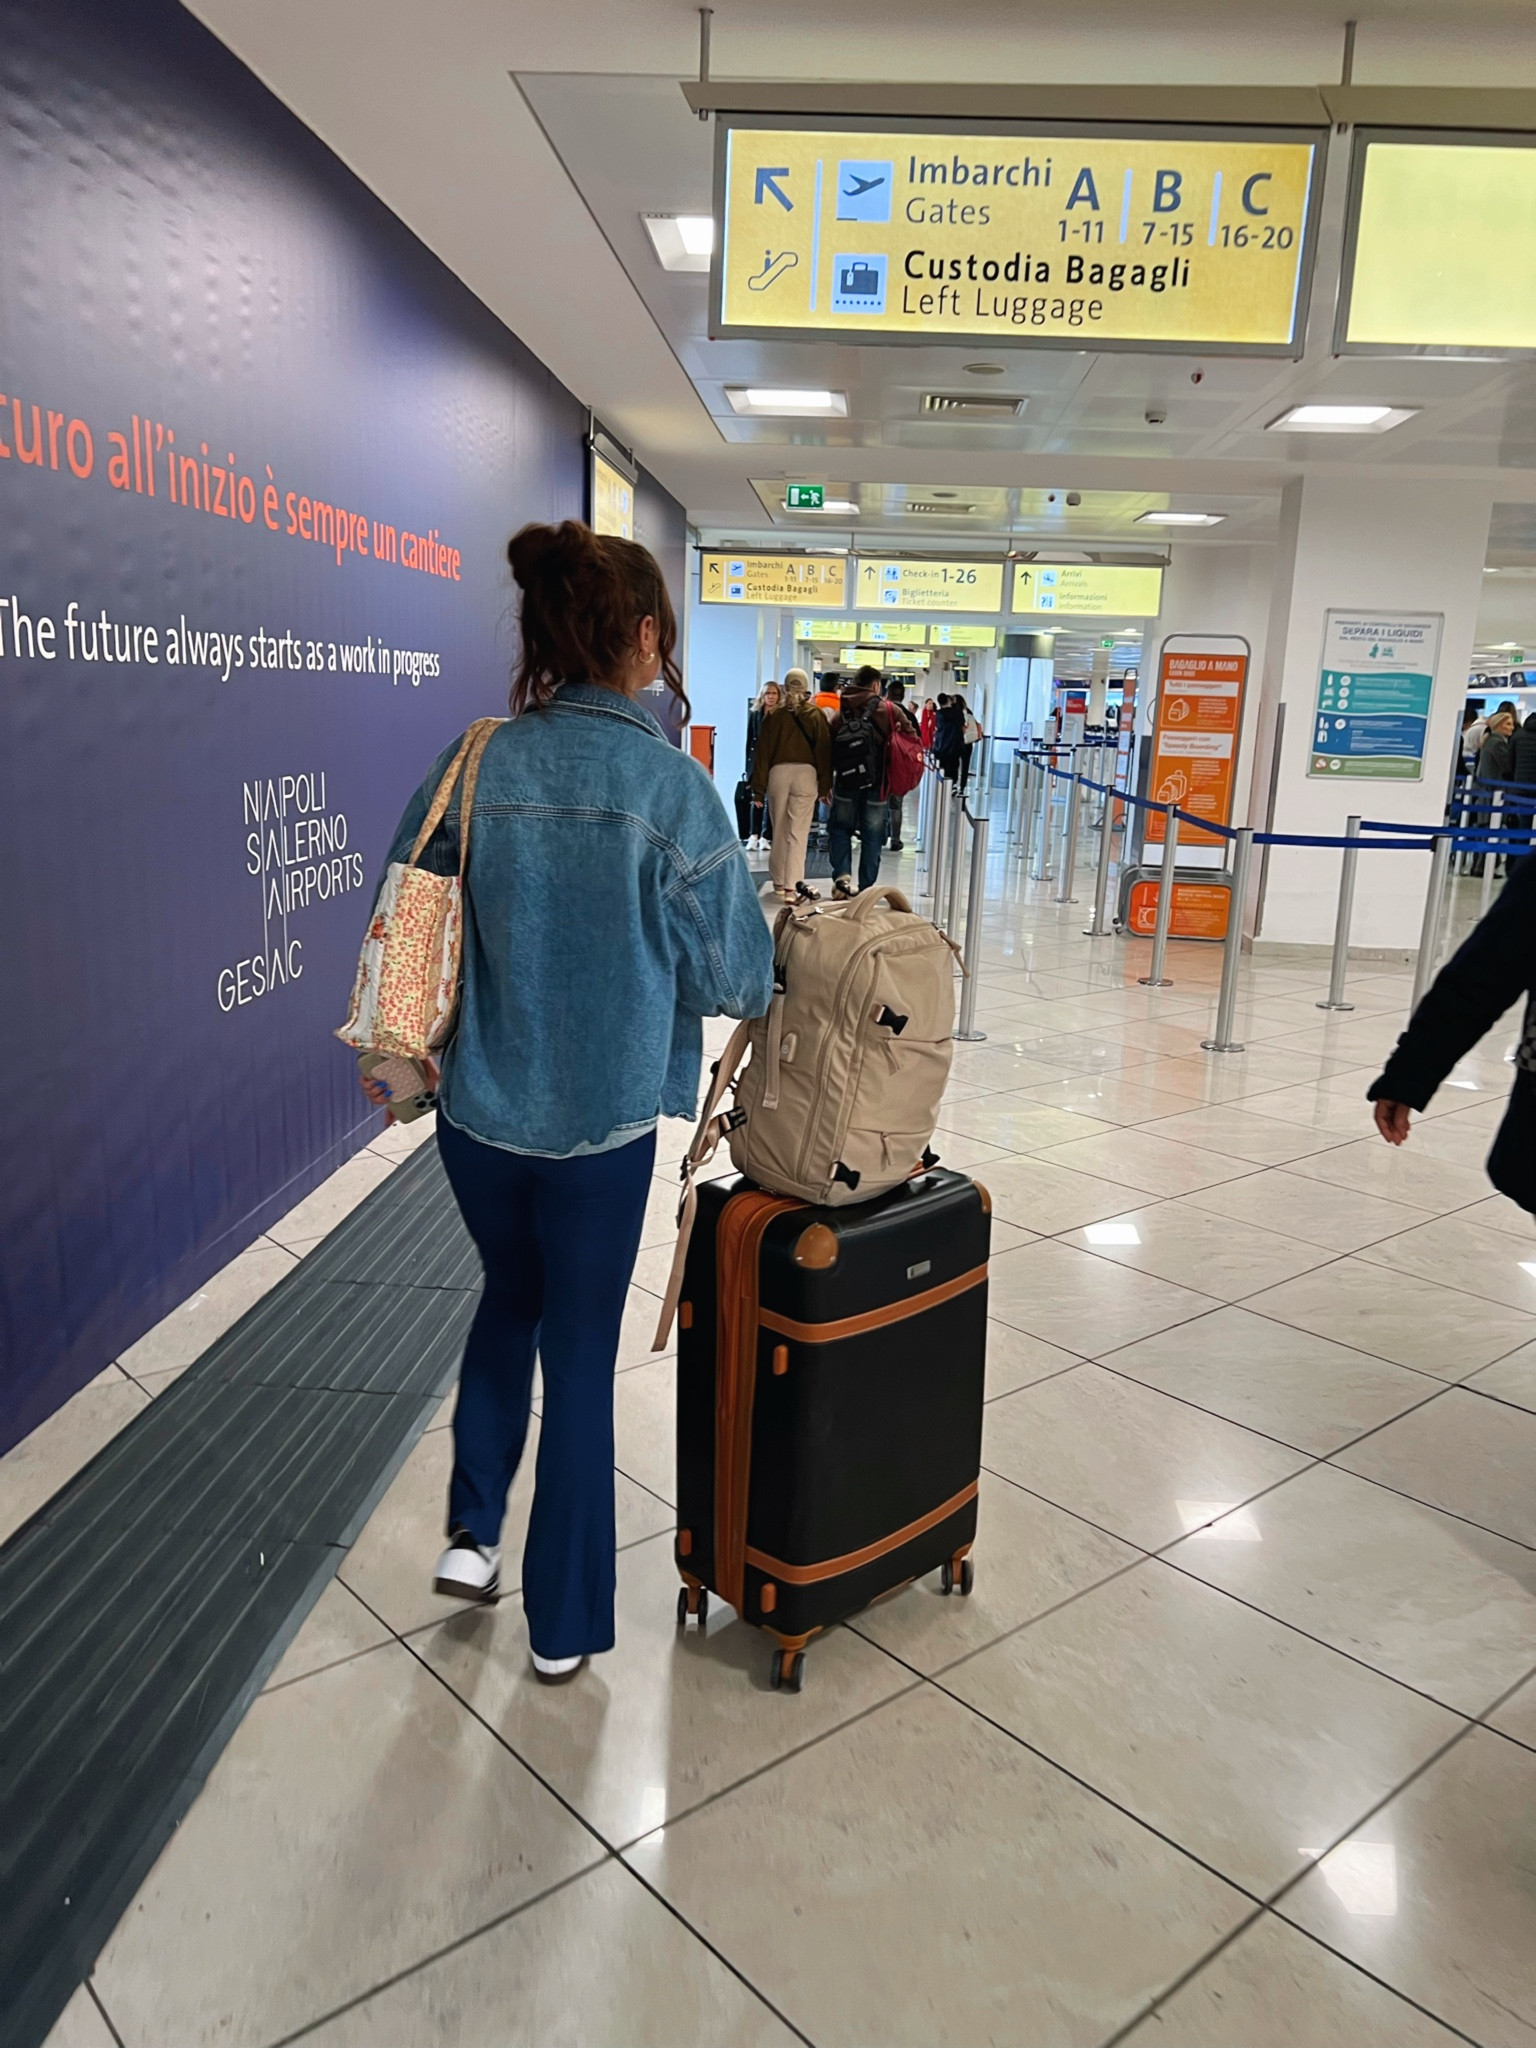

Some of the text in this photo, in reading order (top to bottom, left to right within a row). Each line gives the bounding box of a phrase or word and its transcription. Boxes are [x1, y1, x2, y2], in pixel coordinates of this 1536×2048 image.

[909, 155, 1272, 215] Imbarchi A B C
[906, 197, 990, 225] Gates
[1058, 220, 1293, 249] 1-11 7-15 16-20
[904, 250, 1190, 292] Custodia Bagagli
[903, 285, 1103, 326] Left Luggage
[263, 463, 280, 531] è
[285, 491, 369, 566] sempre
[373, 521, 397, 563] un
[400, 529, 461, 581] cantiere
[746, 561, 837, 577] Imbarchi A B C
[902, 567, 977, 584] Check-in 1-26
[746, 583, 818, 595] Custodia Bagagli
[746, 591, 797, 602] Left Luggage
[902, 588, 949, 598] Biglietteria
[0, 595, 440, 686] The future always starts as a work in progress
[1342, 626, 1379, 636] SEPARA
[1387, 628, 1423, 638] LIQUIDI
[1169, 659, 1239, 672] BAGAGLIO A MANO
[243, 771, 326, 825] NAPOLI
[246, 813, 347, 875] SALERNO
[267, 852, 364, 920] AIRPORTS
[217, 940, 303, 1012] GESAC
